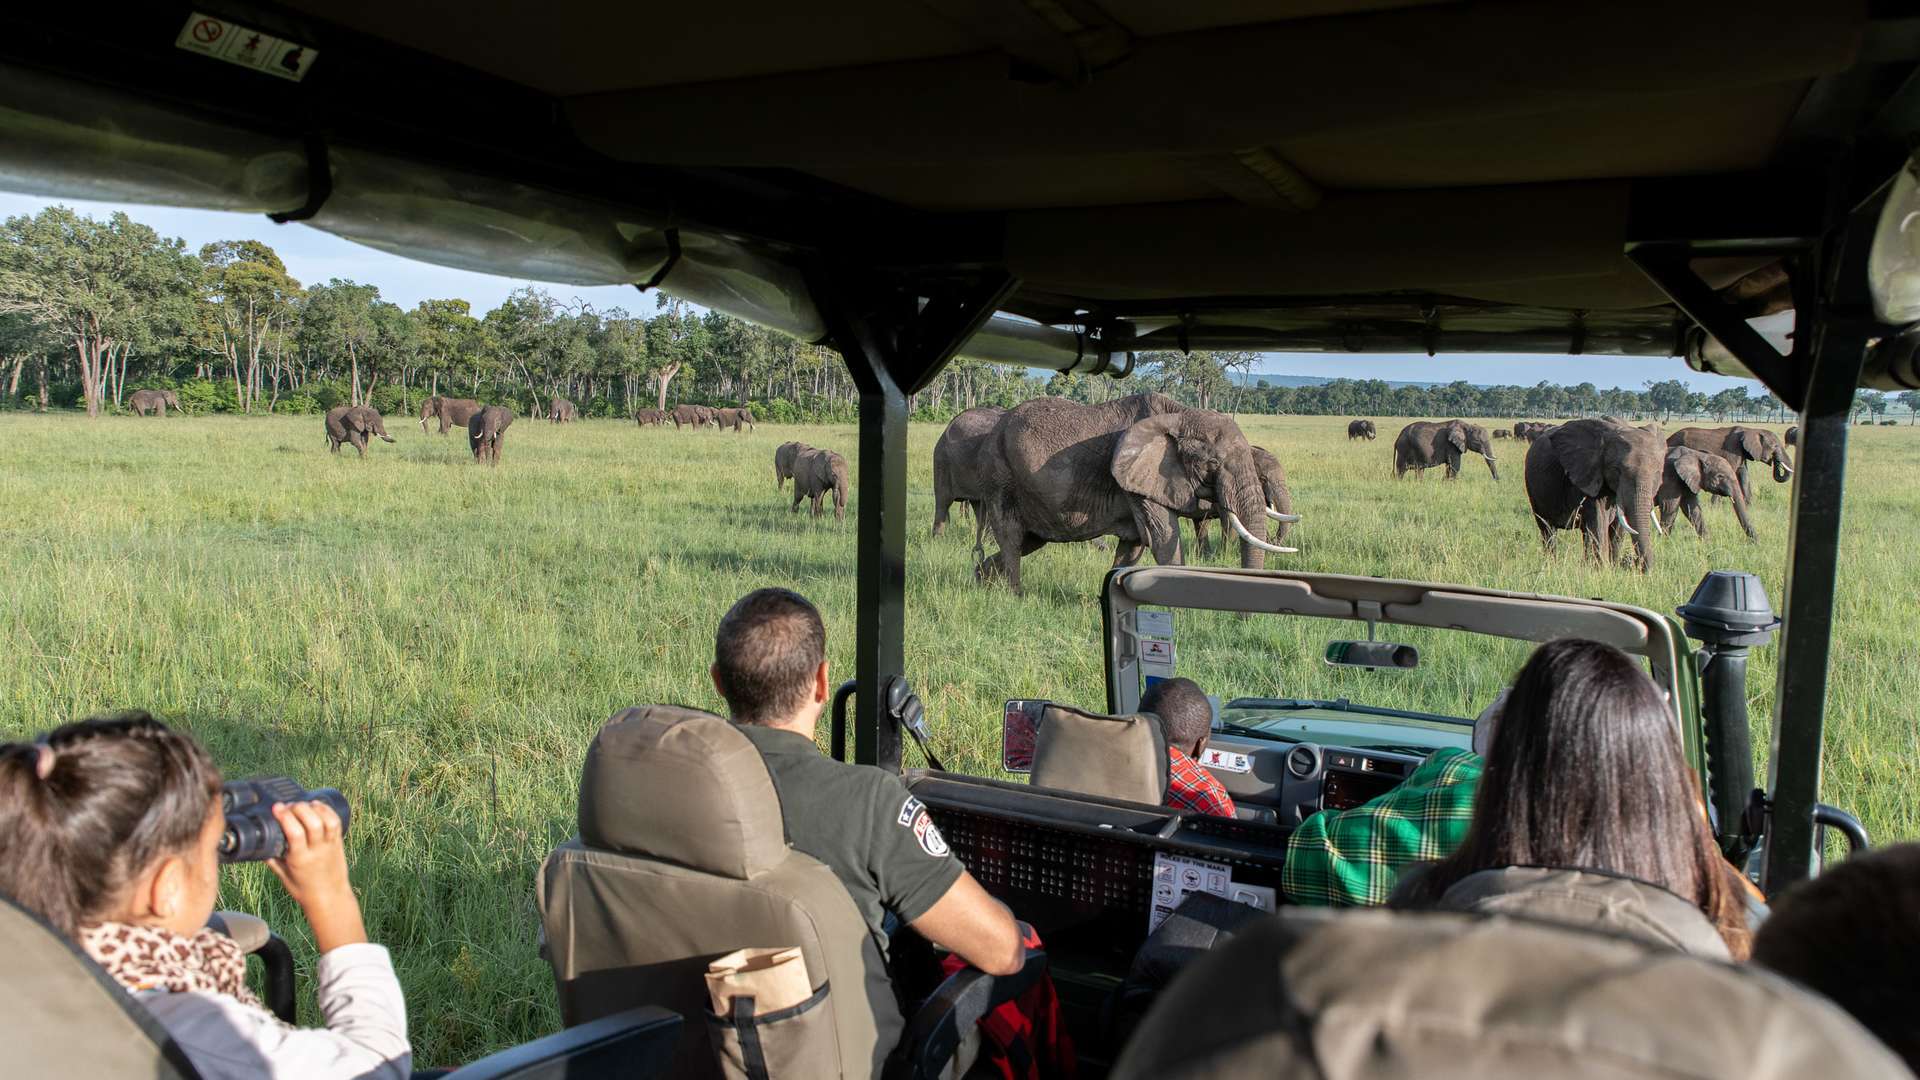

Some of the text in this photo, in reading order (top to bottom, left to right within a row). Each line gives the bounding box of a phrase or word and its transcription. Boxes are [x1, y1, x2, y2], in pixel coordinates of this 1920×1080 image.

[1160, 854, 1181, 863] RULES
[1192, 860, 1205, 868] THE
[1206, 863, 1226, 872] MARA
